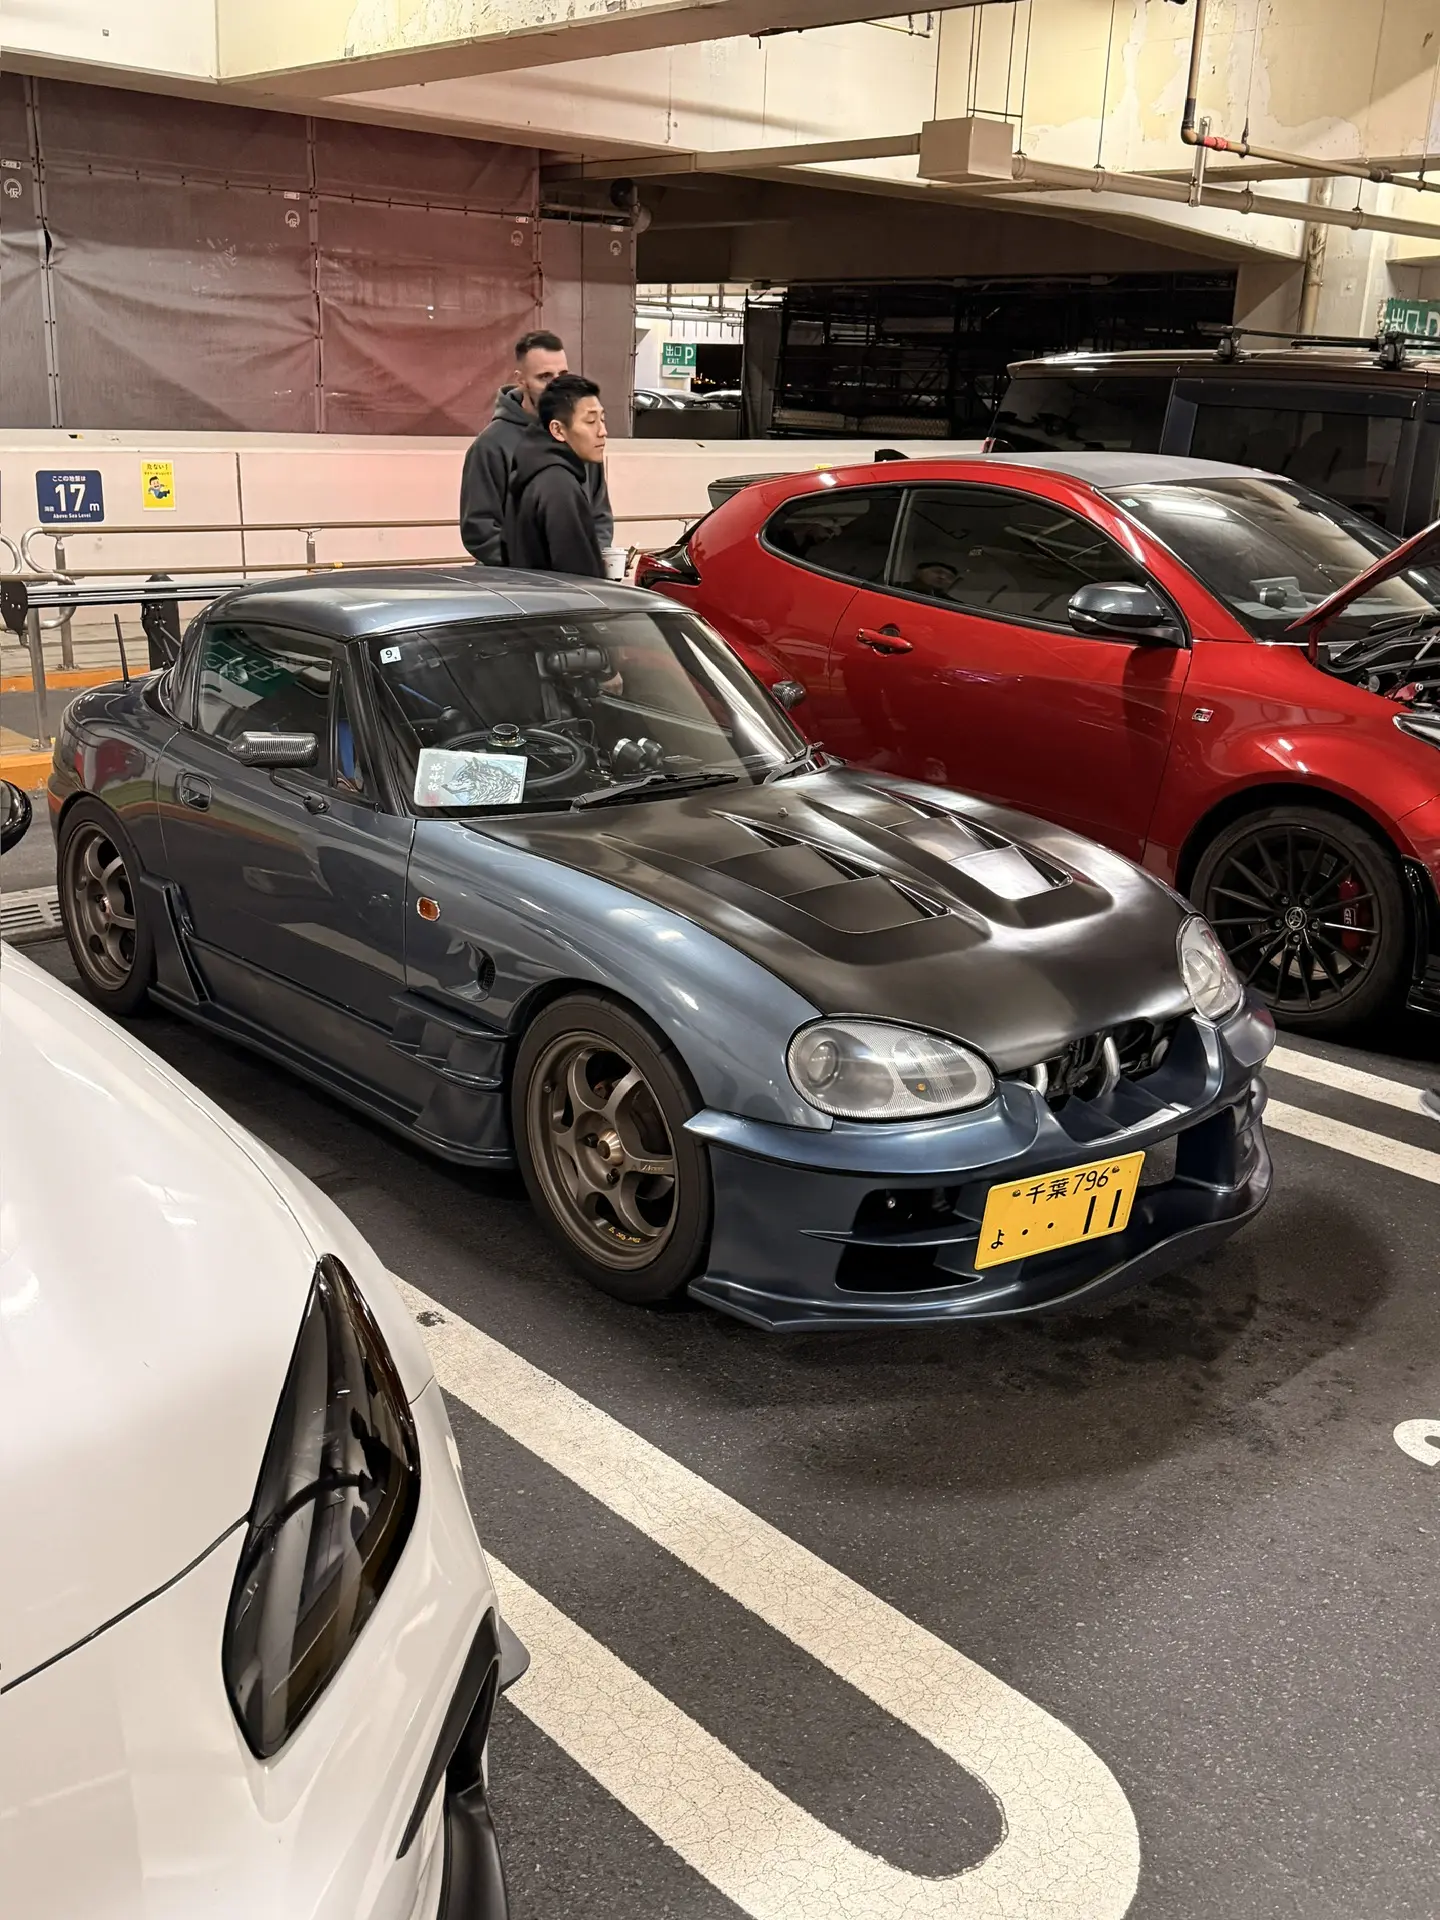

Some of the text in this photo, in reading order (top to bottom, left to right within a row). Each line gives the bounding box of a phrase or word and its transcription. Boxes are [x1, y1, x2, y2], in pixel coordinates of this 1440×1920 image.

[665, 345, 694, 365] 出口 P
[55, 483, 86, 512] 17
[89, 502, 100, 512] m
[1025, 1167, 1110, 1204] 千葉 796
[990, 1229, 1005, 1249] よ
